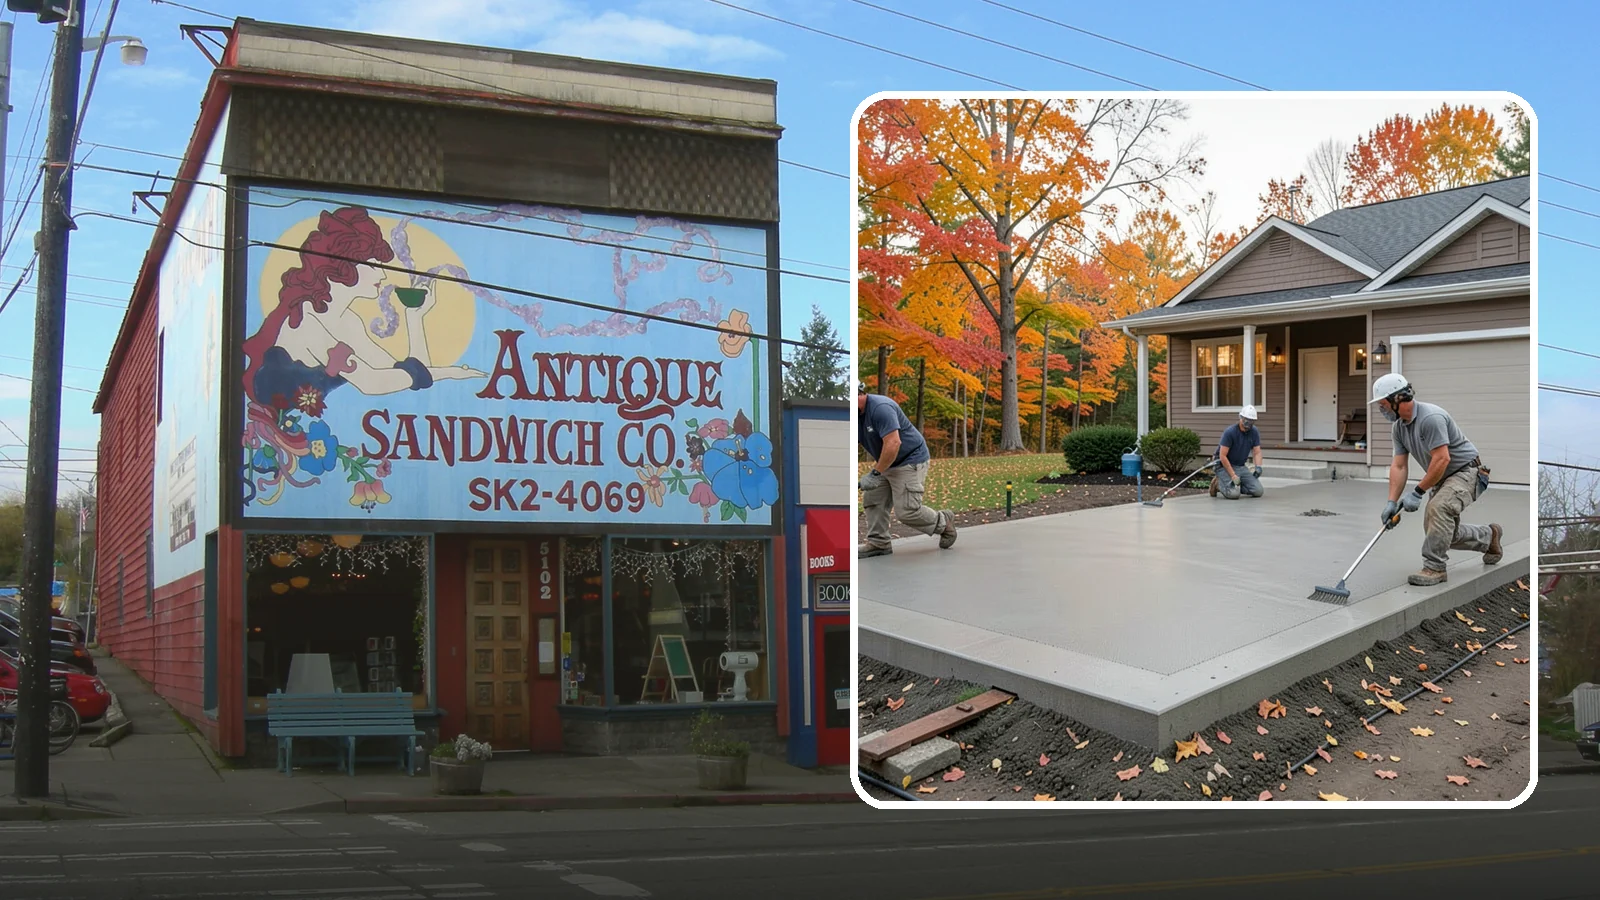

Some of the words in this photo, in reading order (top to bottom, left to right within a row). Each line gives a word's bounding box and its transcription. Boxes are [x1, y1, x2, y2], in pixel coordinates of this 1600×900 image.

[362, 408, 604, 468] SANDWICH
[617, 420, 685, 469] CO.
[469, 476, 645, 513] SK2-4069
[540, 541, 552, 600] 5102
[809, 555, 835, 569] BOOKS
